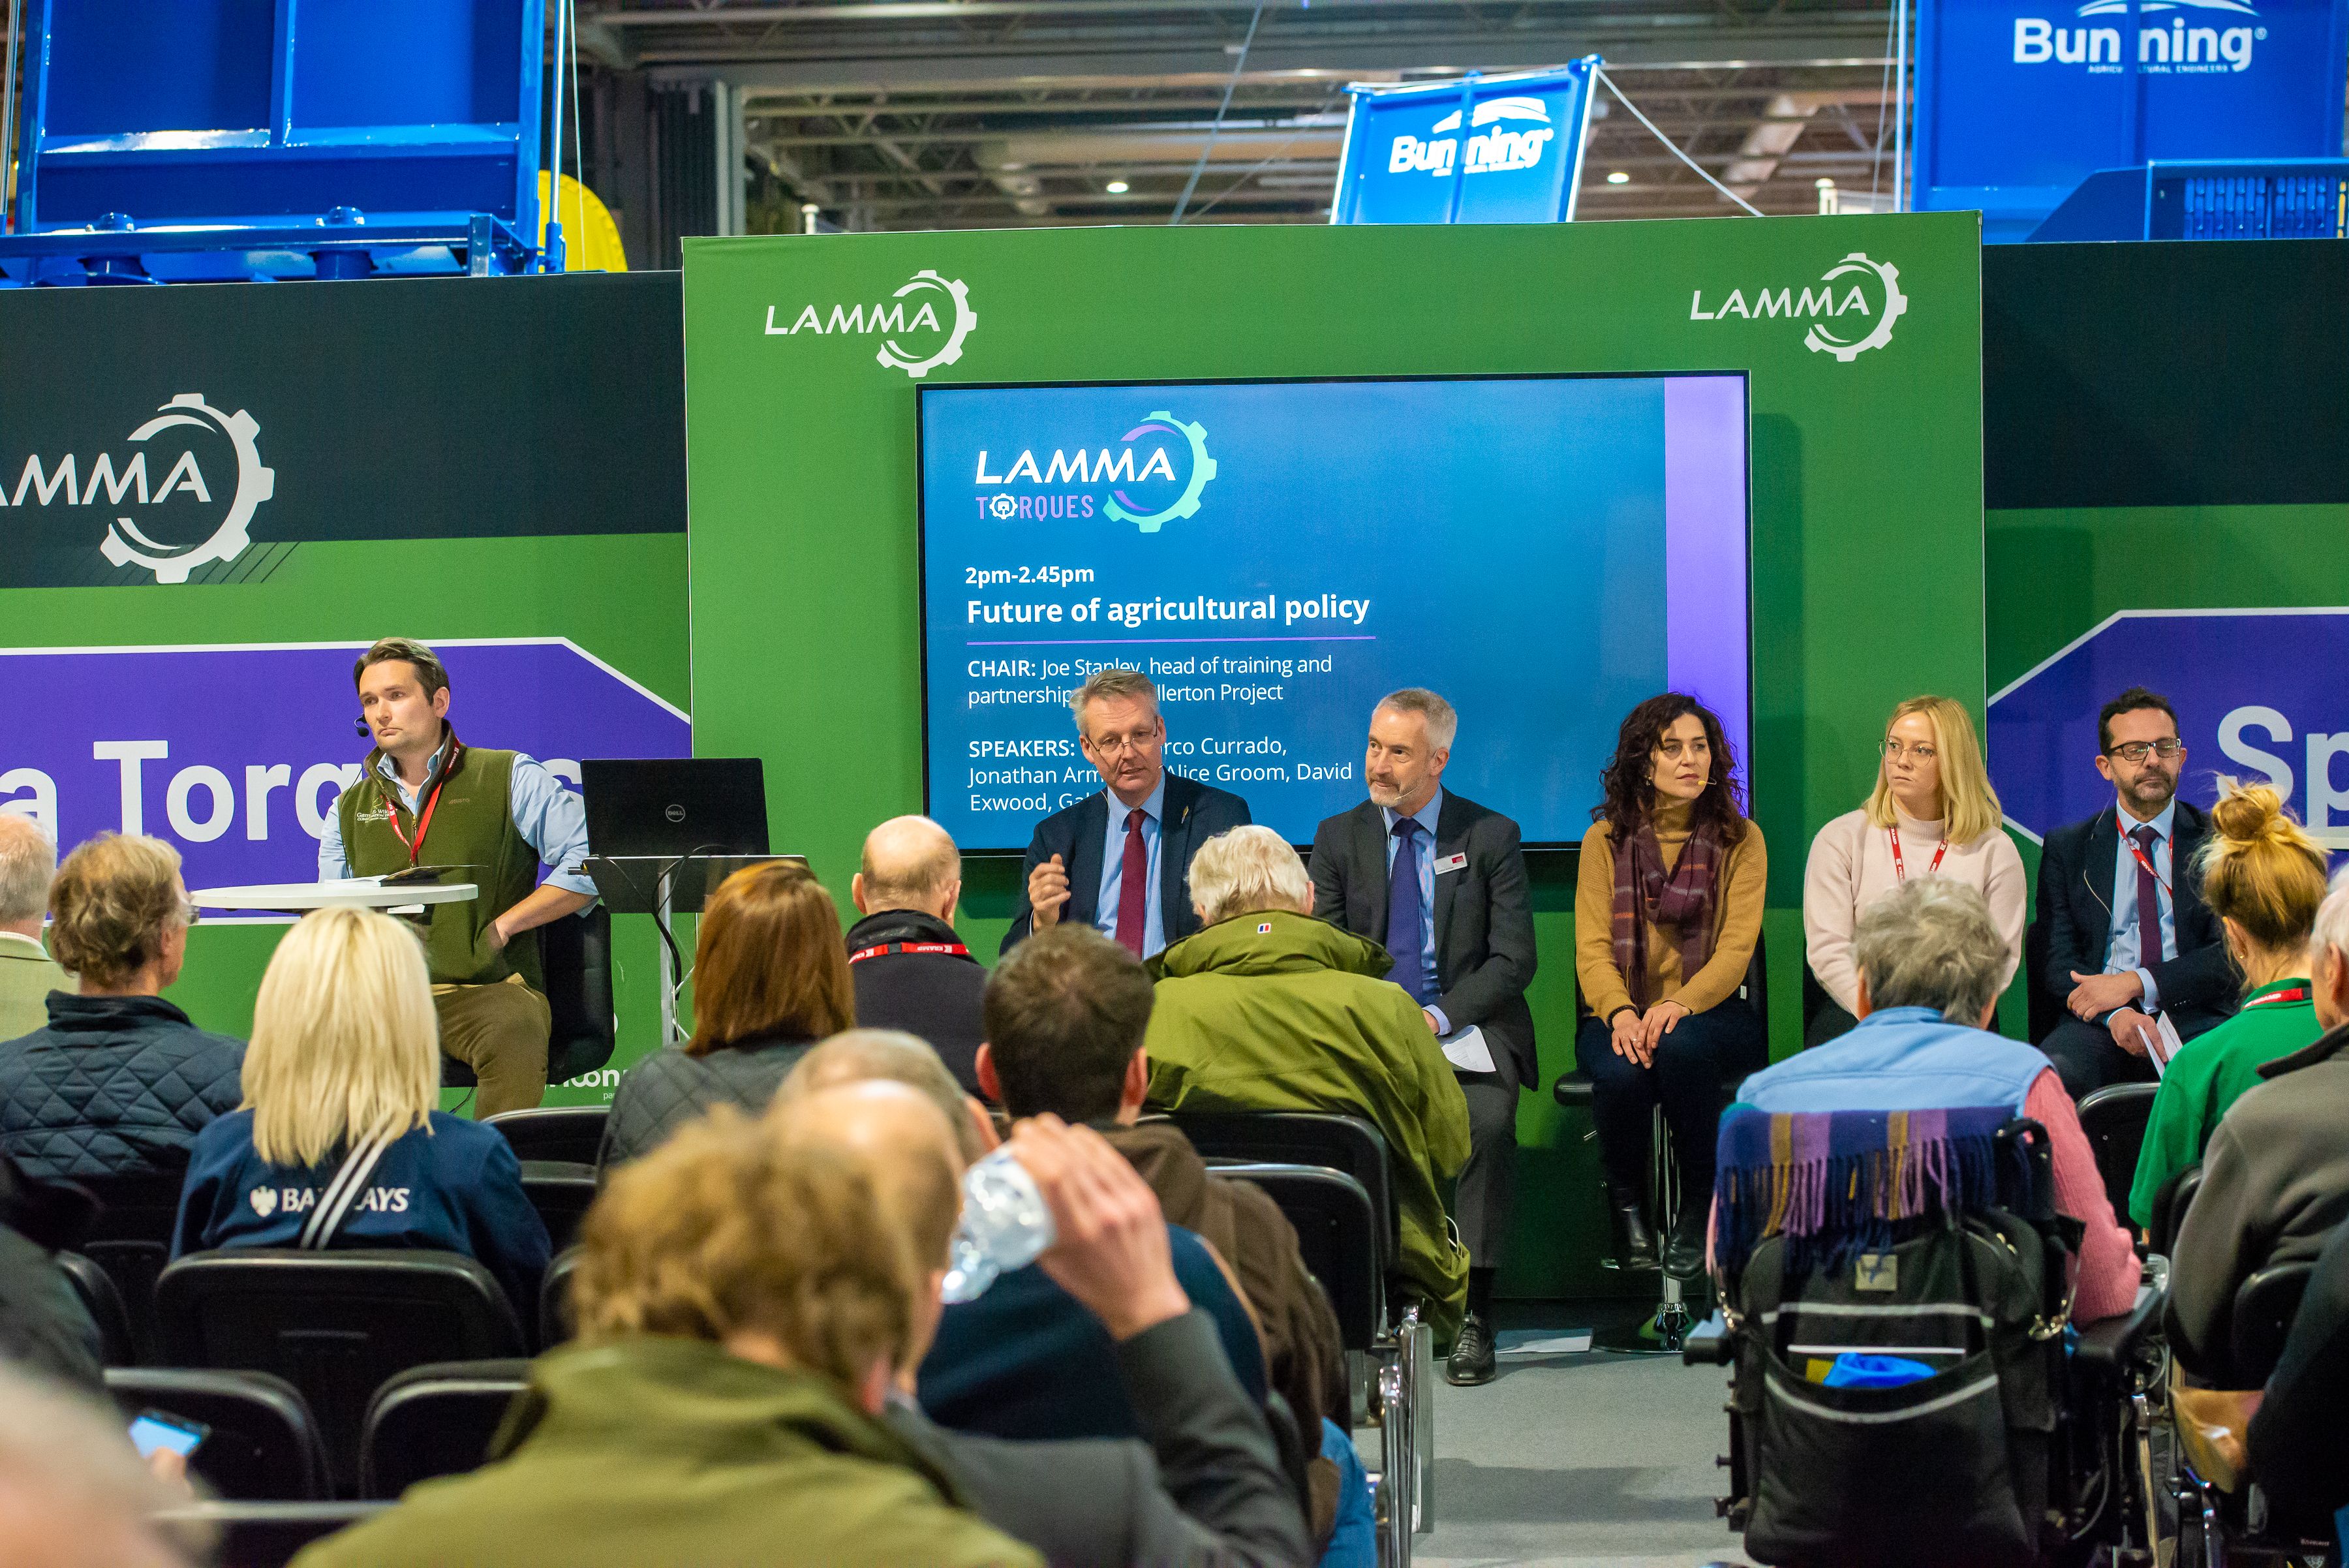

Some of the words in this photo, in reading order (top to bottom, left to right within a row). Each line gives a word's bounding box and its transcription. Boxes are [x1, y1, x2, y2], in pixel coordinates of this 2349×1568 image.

[2014, 17, 2253, 72] Bunning
[1691, 286, 1870, 320] LAMMA
[765, 303, 940, 335] LAMMA
[0, 450, 212, 506] MMA
[975, 448, 1176, 484] LAMMA
[965, 566, 1094, 589] 2pm-2.45pm
[968, 600, 1063, 624] Future
[1071, 597, 1101, 622] of
[1108, 595, 1276, 628] agricultural
[1285, 593, 1370, 626] policy
[968, 660, 1036, 677] CHAIR:
[1040, 659, 1070, 680] Joe
[1150, 656, 1195, 675] head
[1201, 656, 1220, 674] of
[1223, 656, 1293, 678] training
[1298, 654, 1332, 673] and
[1158, 684, 1215, 701] llerton
[1221, 682, 1283, 705] Project
[969, 739, 1075, 758] SPEAKERS:
[1201, 736, 1287, 758] Currado,
[968, 766, 1057, 788] Jonathan
[1217, 764, 1292, 785] Groom,
[1297, 761, 1352, 780] David
[970, 792, 1052, 816] Exwood,
[282, 1187, 410, 1212] BAAYS
